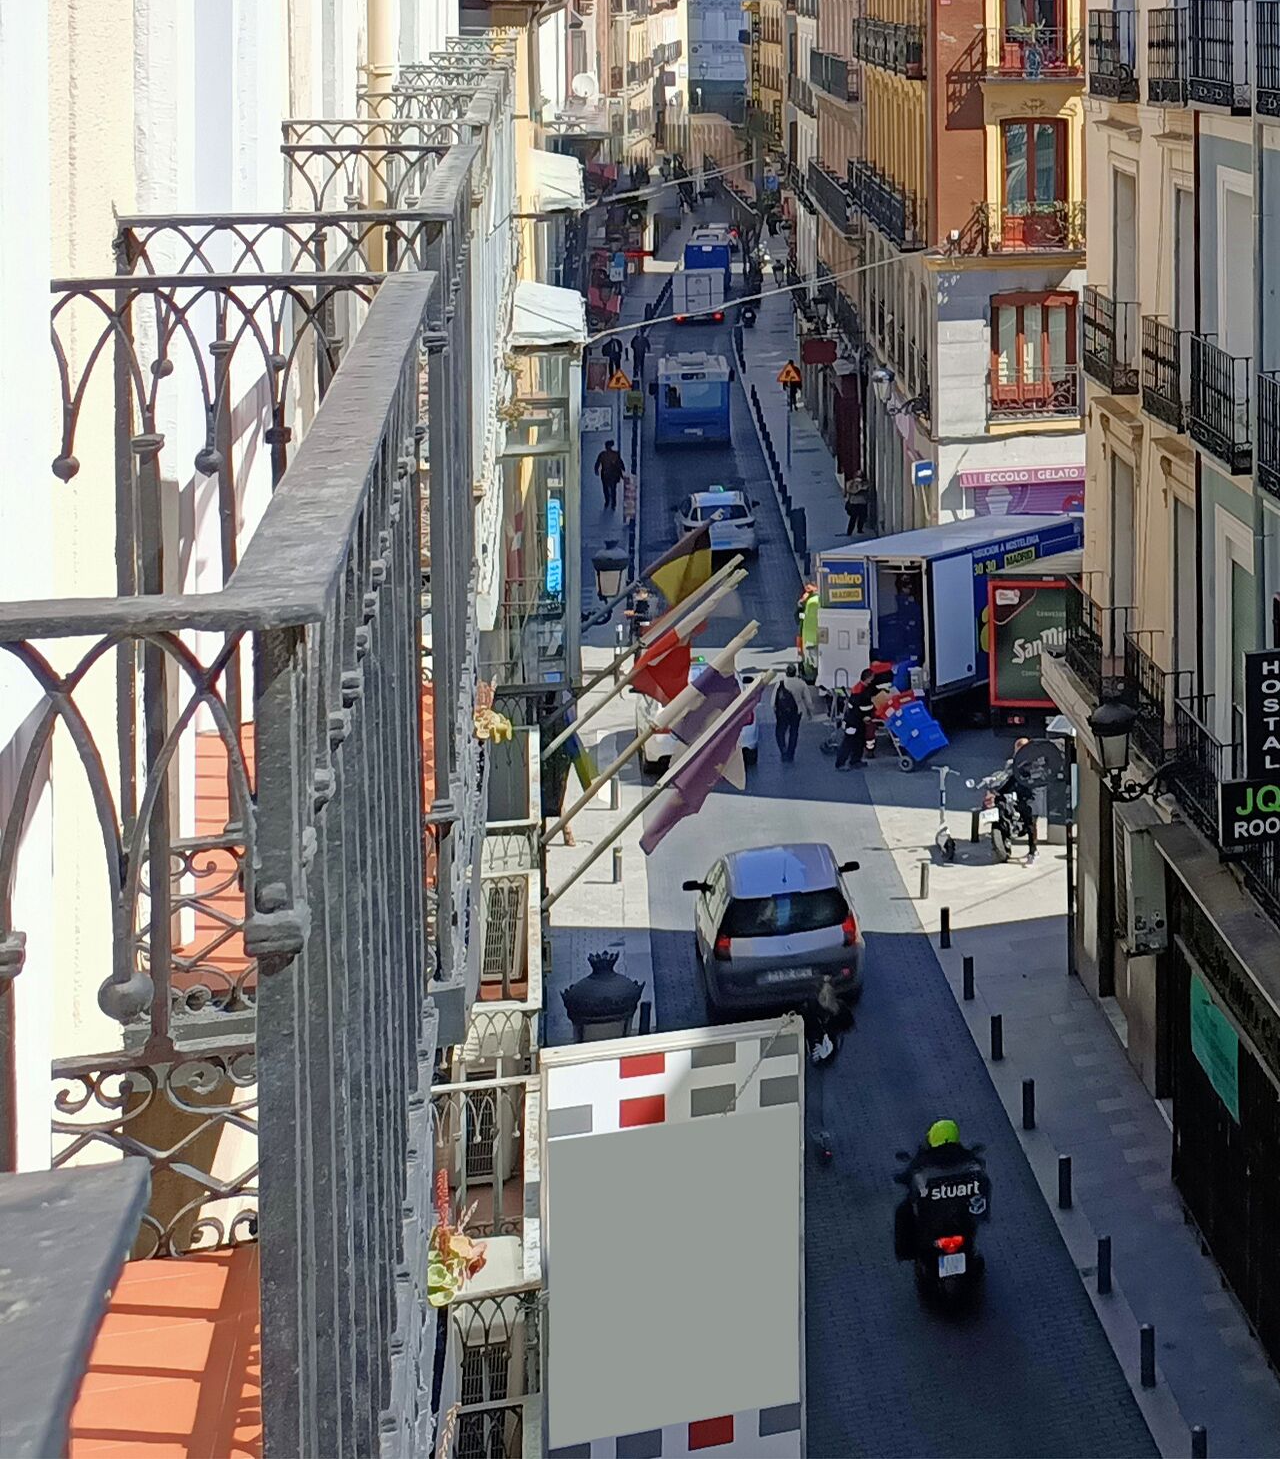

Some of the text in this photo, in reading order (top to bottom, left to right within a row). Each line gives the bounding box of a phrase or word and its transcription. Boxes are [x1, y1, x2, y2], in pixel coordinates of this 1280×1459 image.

[984, 468, 1079, 483] ECCOLO GELATO
[828, 572, 862, 584] makro
[931, 1180, 980, 1200] stuart
